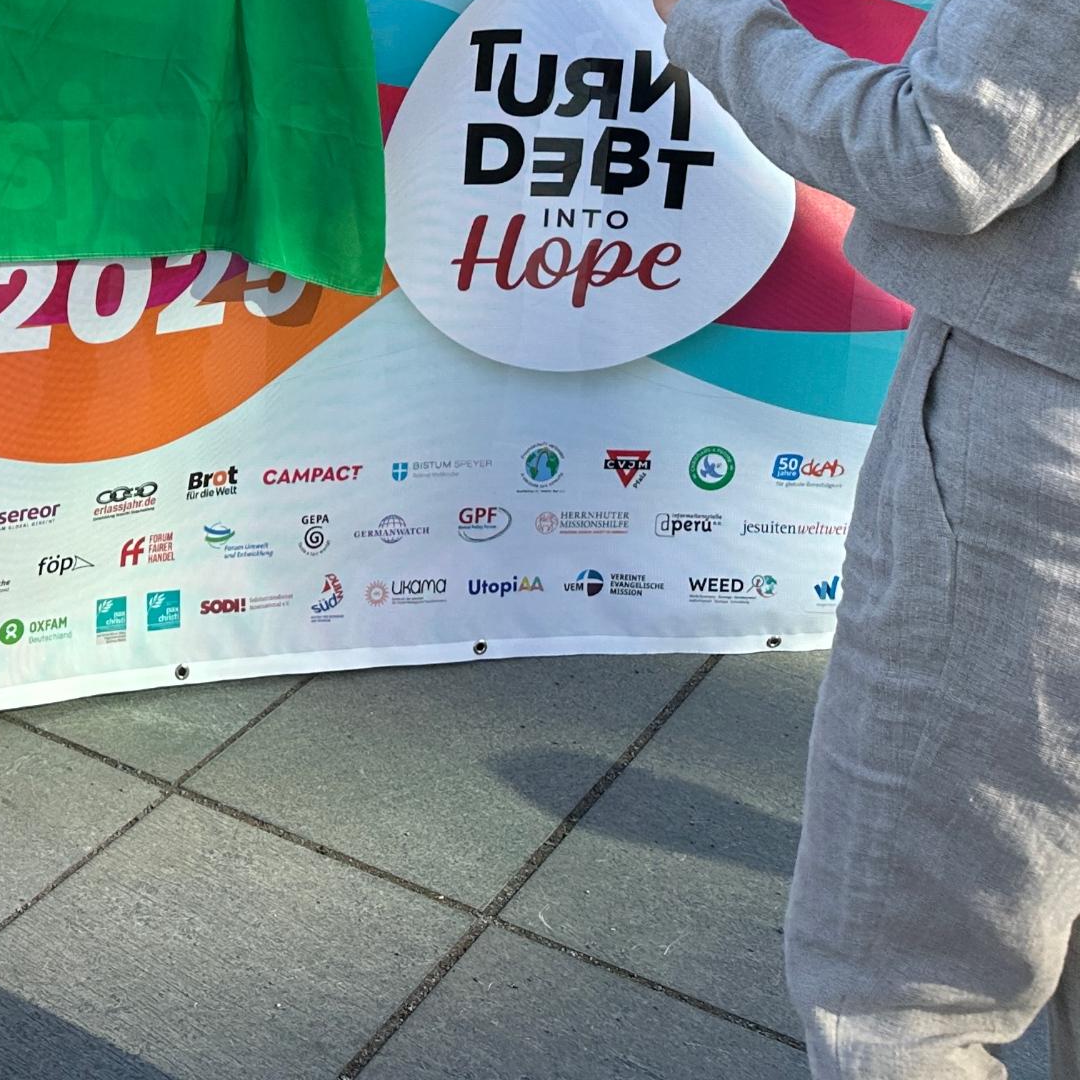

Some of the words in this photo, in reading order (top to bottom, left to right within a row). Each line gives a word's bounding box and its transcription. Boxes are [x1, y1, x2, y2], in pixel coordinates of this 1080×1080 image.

[542, 207, 629, 231] INTO
[451, 213, 682, 309] Hope
[606, 460, 650, 471] CVJM
[778, 457, 800, 471] 50
[187, 465, 239, 491] Brot
[262, 465, 364, 486] CAMPACT
[186, 488, 199, 501] für
[200, 487, 215, 499] die
[216, 485, 238, 497] Welt
[93, 496, 157, 517] erlassjahr.de
[560, 510, 630, 520] HERRNHUTER
[301, 513, 330, 525] GEPA
[458, 506, 498, 525] GPF
[560, 519, 630, 529] MISSIONSHILFE
[352, 525, 431, 539] GERMANWATCH
[739, 518, 848, 537] jesuitenweltwei
[38, 553, 74, 576] föp
[609, 572, 647, 582] VEREINTE
[609, 580, 665, 591] EVANGELISCHE
[689, 576, 745, 594] WEED
[609, 588, 643, 597] MISSION
[200, 597, 247, 615] SODI!
[29, 616, 69, 633] OXFAM
